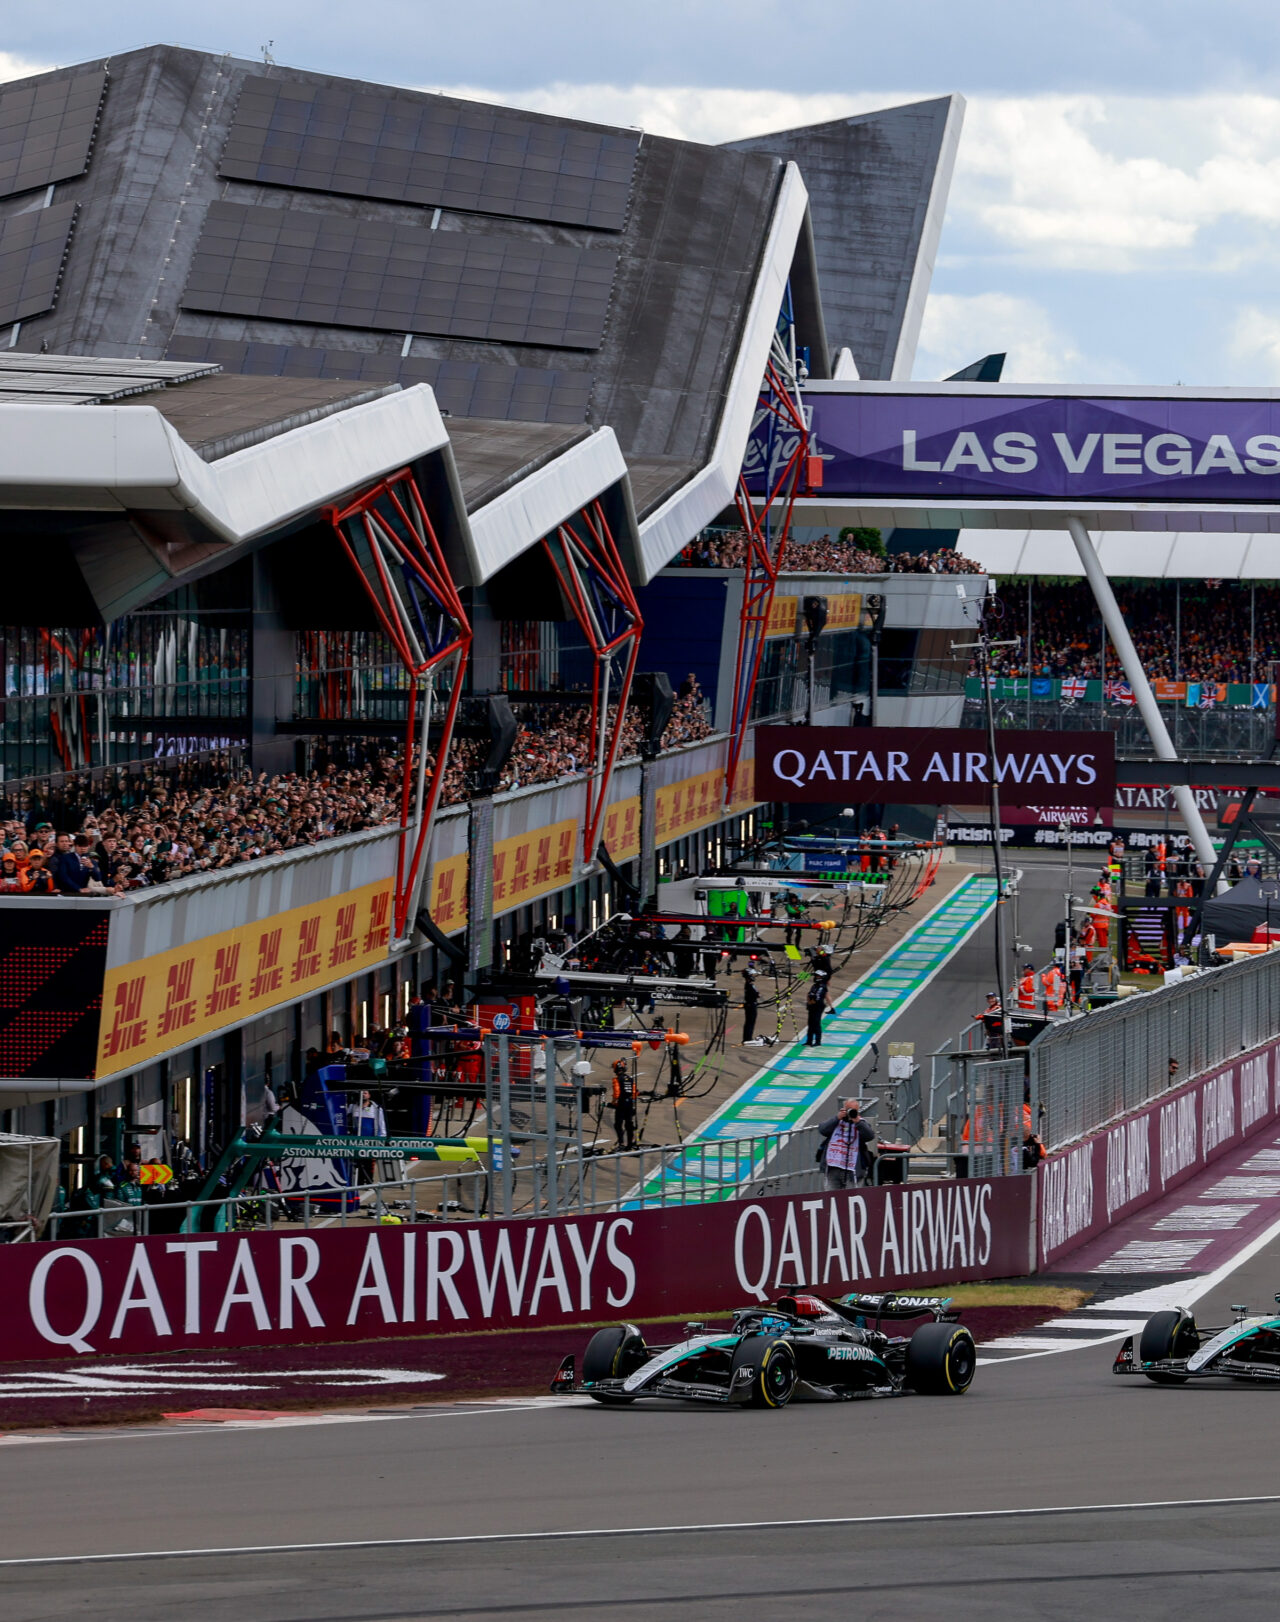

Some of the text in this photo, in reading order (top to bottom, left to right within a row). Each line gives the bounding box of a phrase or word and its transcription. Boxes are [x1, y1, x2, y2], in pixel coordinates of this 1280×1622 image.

[902, 429, 1037, 474] LAS
[773, 749, 911, 788] QATAR
[922, 751, 1096, 785] AIRWAYS
[1038, 811, 1089, 824] AIRWAYS
[282, 1147, 405, 1159] ASTON MARTIN aramco
[734, 1183, 993, 1302] QATAR AIRWAYS
[28, 1217, 636, 1354] QATAR AIRWAYS
[828, 1347, 876, 1361] PETRONAS
[738, 1367, 754, 1379] IWC
